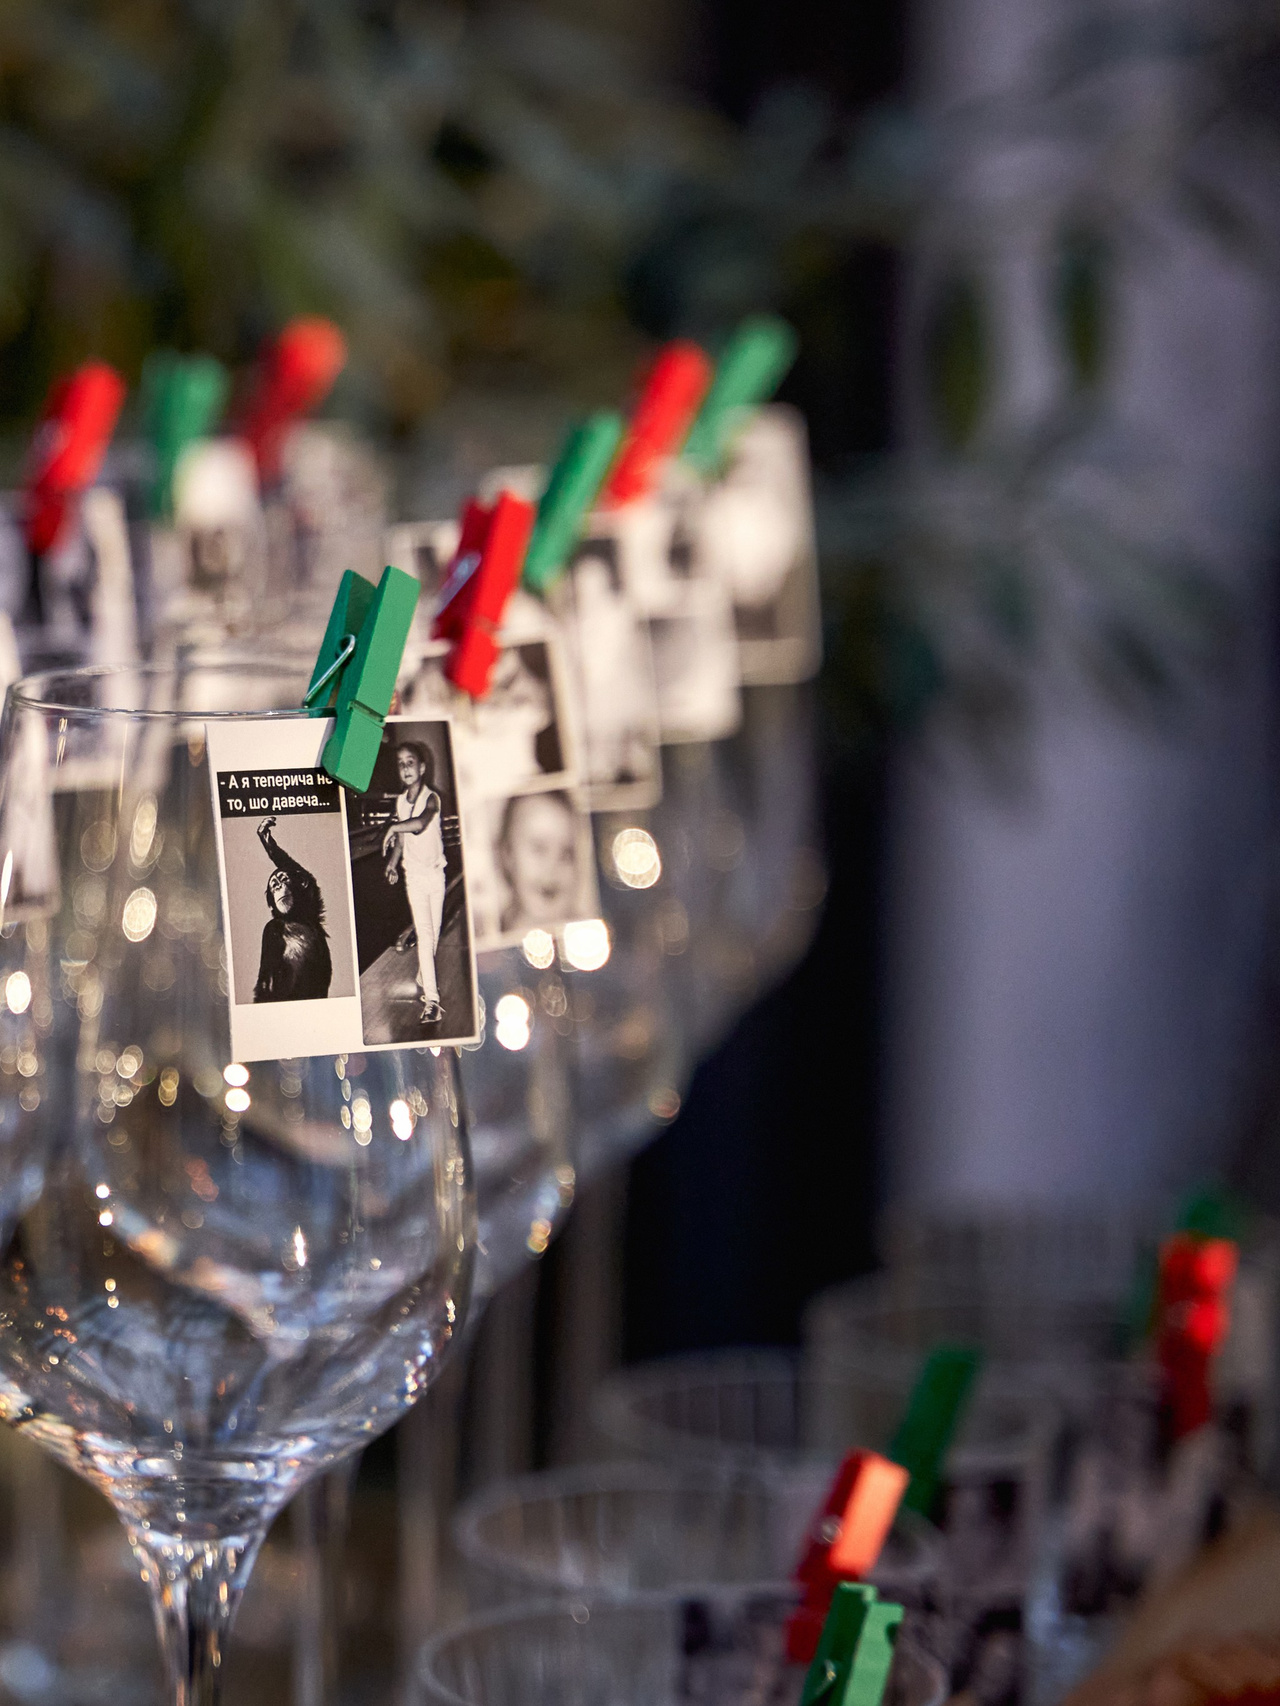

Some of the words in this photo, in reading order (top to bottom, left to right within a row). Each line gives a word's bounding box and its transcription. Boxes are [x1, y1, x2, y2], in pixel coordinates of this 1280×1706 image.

[228, 774, 239, 789] А
[241, 776, 250, 789] я
[252, 773, 314, 790] теперича
[227, 798, 246, 813] то,
[249, 797, 269, 810] шо
[272, 795, 330, 811] давеча...
